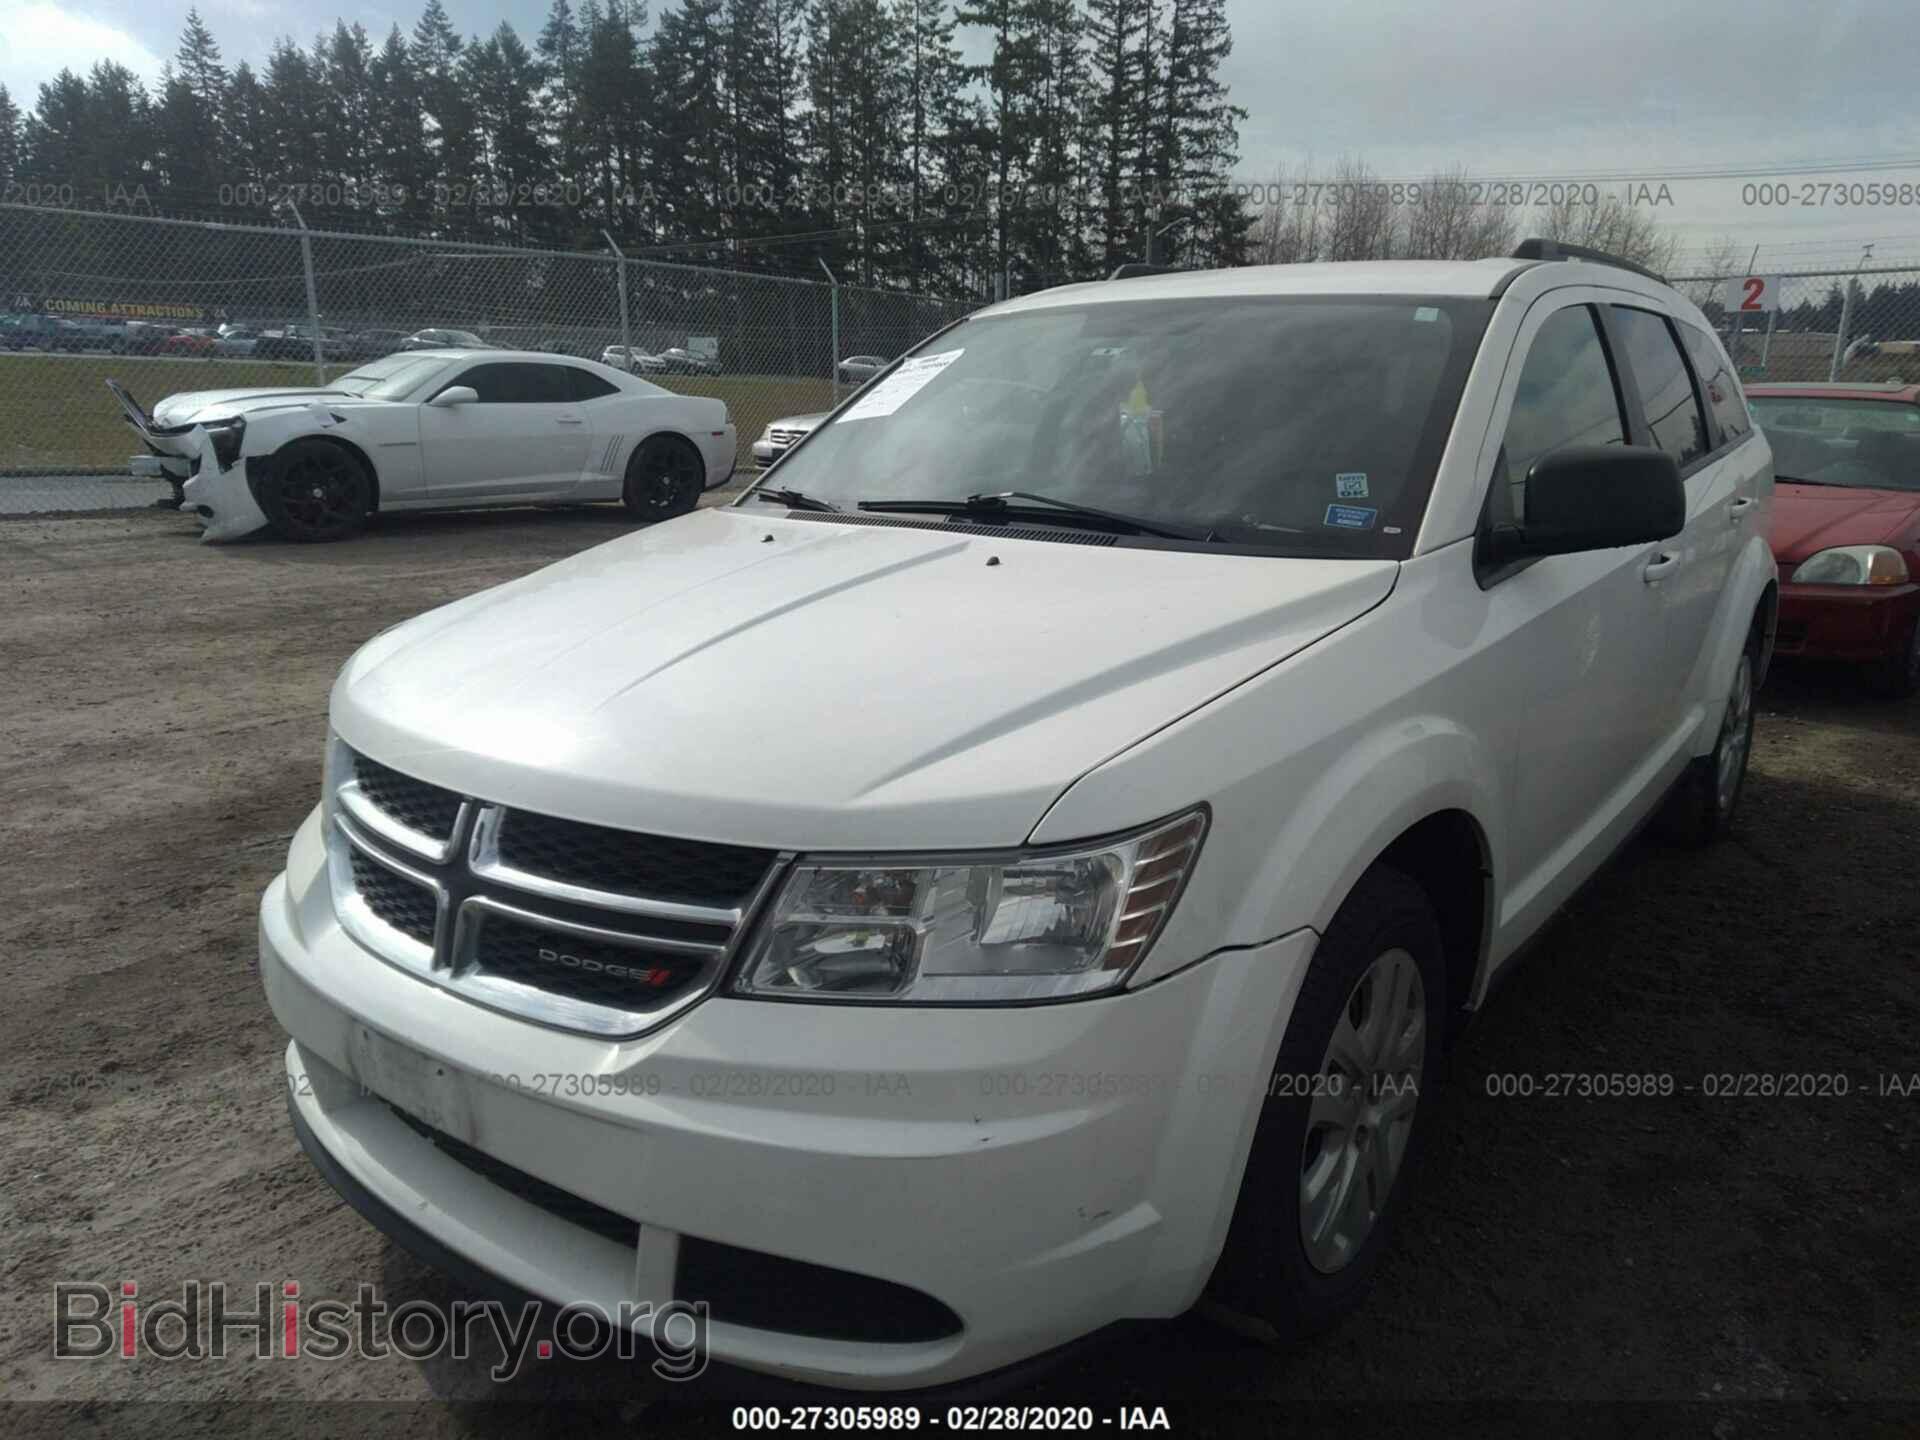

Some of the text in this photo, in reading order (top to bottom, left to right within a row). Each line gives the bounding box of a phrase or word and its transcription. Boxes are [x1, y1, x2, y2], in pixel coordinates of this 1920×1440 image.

[46, 298, 106, 314] COMING
[111, 302, 204, 318] ATTRACTIONS
[1741, 276, 1766, 311] 2
[538, 949, 651, 981] DODGE
